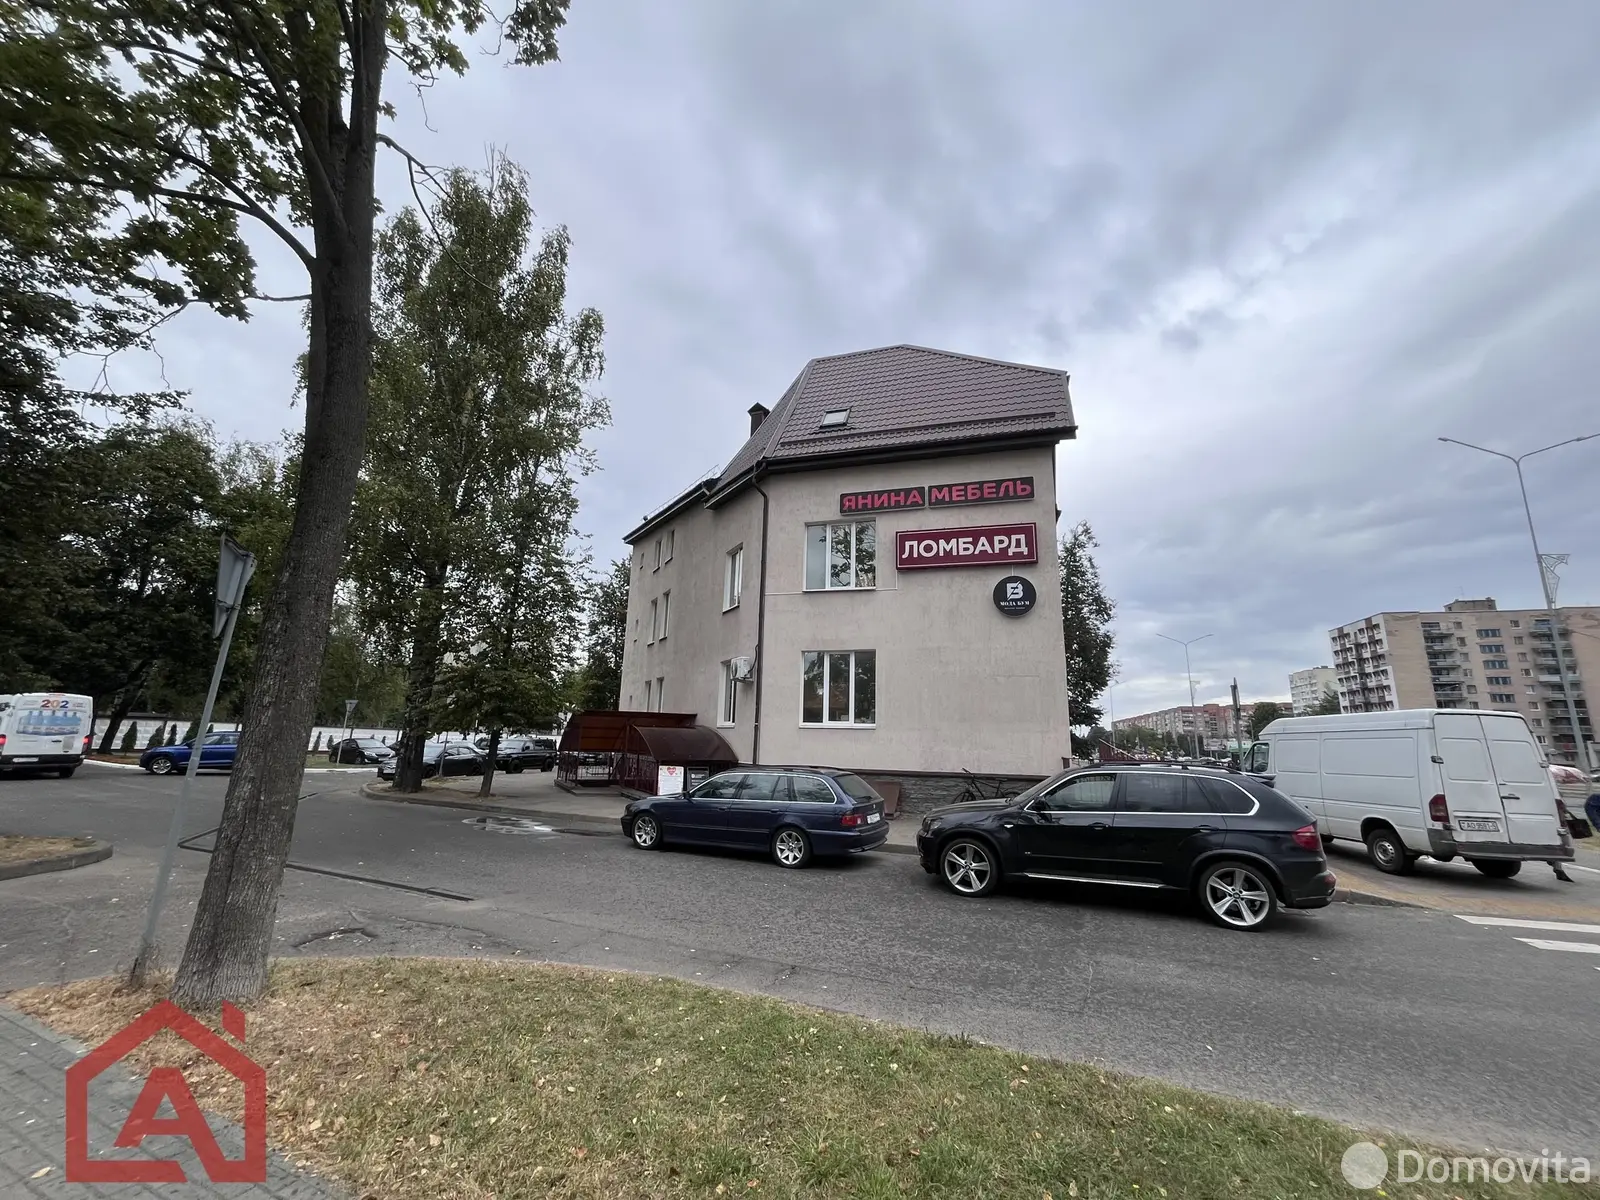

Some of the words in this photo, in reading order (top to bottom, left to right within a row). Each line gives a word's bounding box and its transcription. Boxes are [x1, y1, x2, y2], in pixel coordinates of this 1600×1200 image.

[842, 489, 923, 511] ЯНИНА
[931, 480, 1032, 503] МЕБЕЛЬ
[902, 534, 1028, 559] ЛОМБАРД
[41, 699, 69, 709] 202
